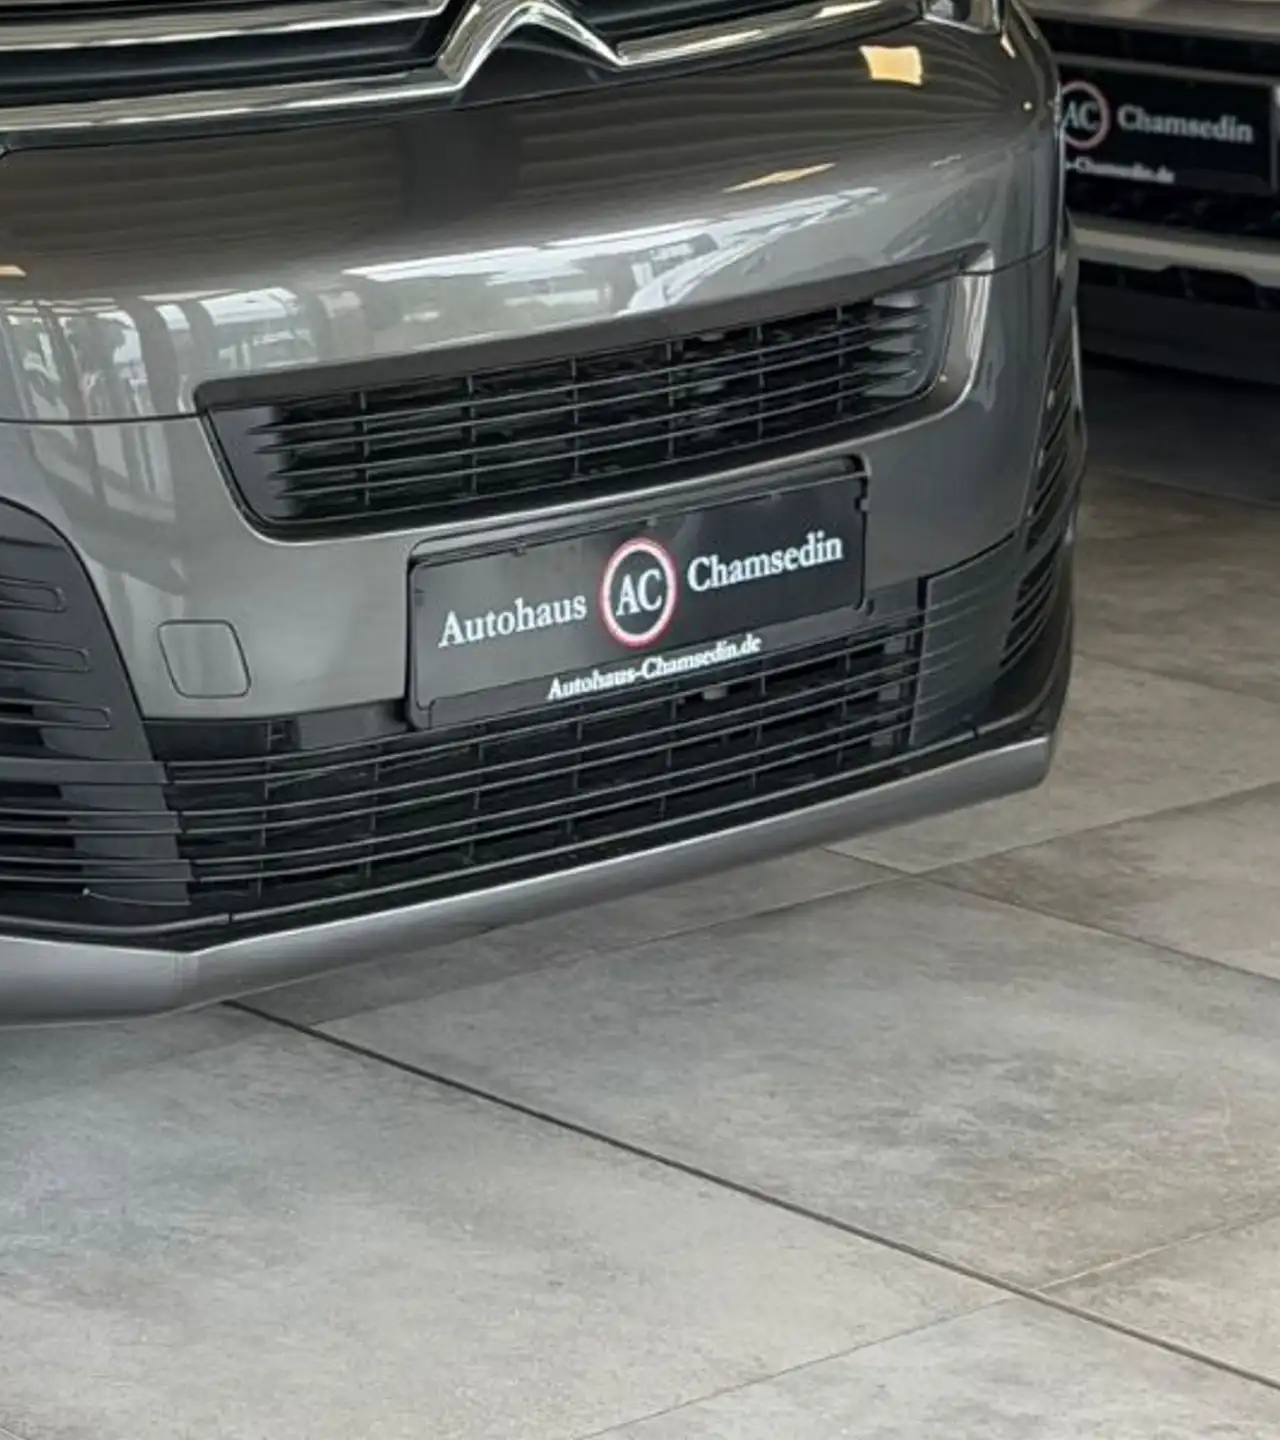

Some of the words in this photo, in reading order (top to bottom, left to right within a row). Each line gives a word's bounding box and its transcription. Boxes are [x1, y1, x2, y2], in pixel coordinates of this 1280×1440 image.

[1061, 100, 1098, 131] AC
[1116, 104, 1254, 144] Chamsedin
[437, 593, 588, 648] Autohaus
[615, 568, 664, 617] AC
[687, 530, 845, 592] Chamsedin
[546, 633, 762, 701] Autohaus-Chamsedin.de
